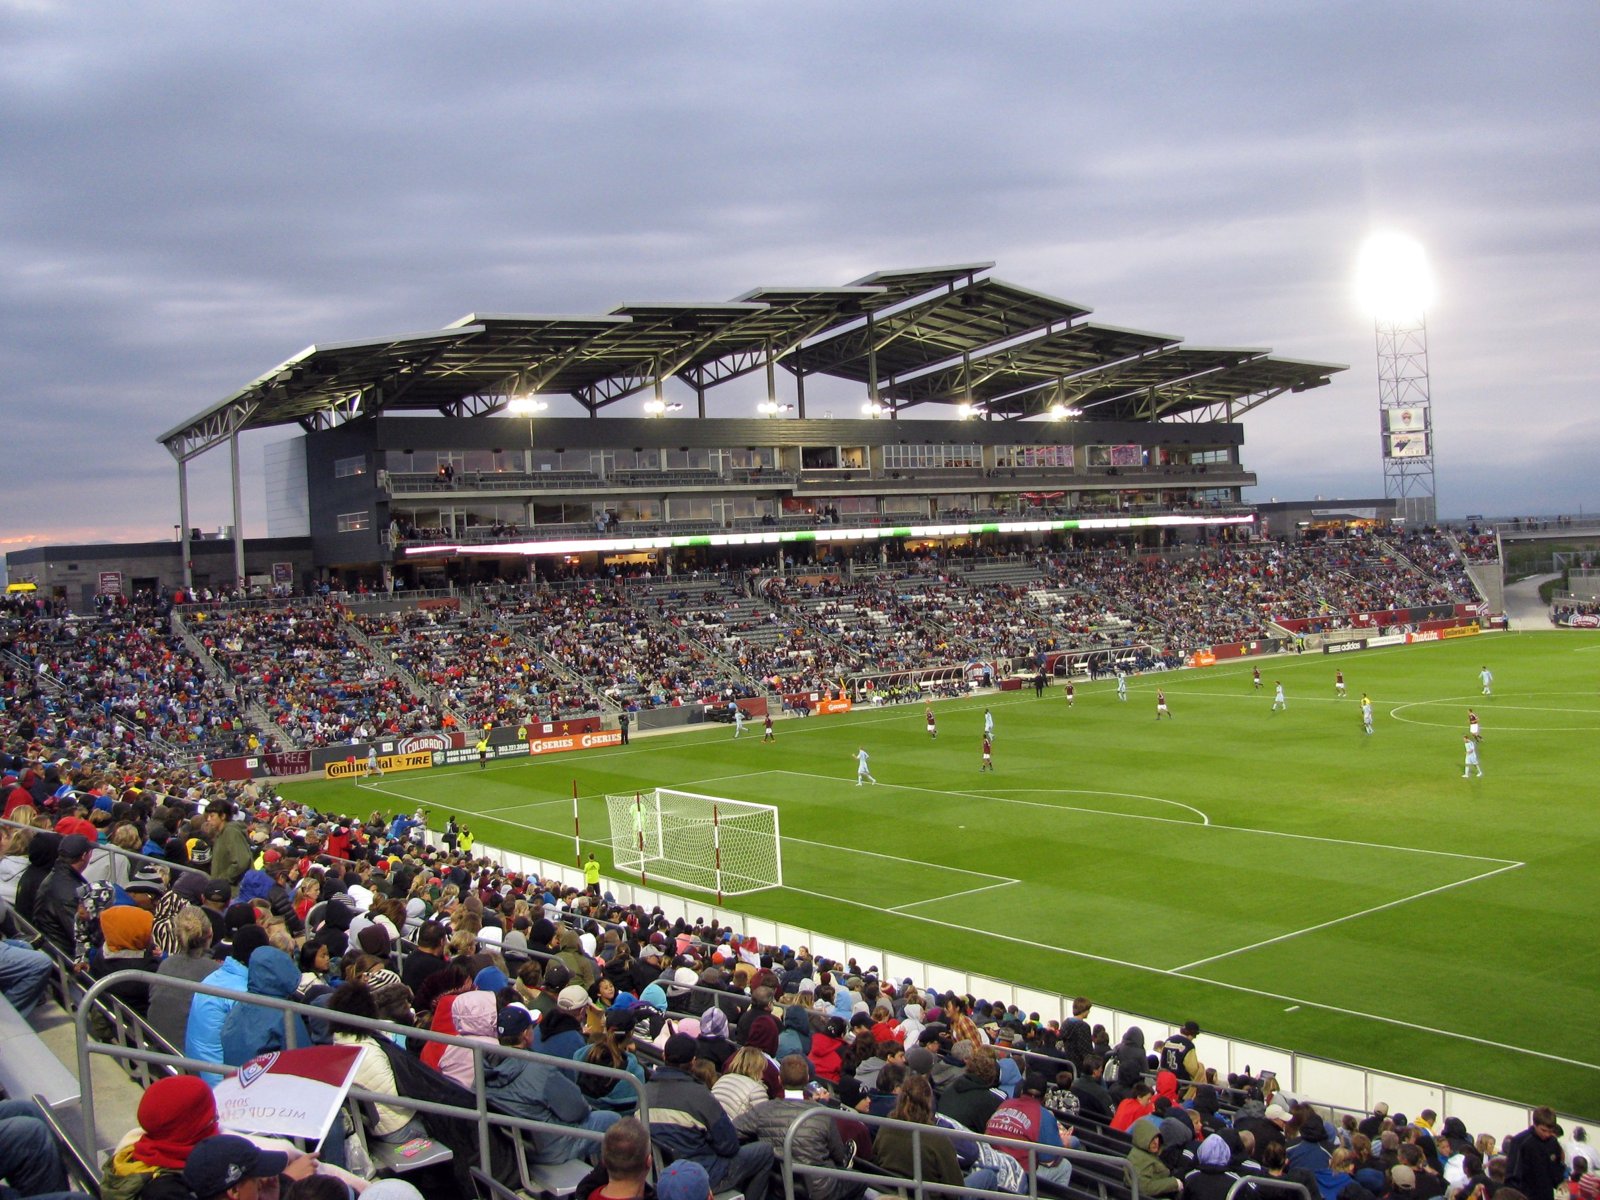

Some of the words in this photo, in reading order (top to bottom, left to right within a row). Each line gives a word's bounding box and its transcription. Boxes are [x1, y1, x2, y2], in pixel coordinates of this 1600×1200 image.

[1341, 642, 1360, 651] adidas
[407, 738, 443, 754] COLORADO
[275, 752, 305, 764] FREE
[405, 755, 430, 766] TIRE
